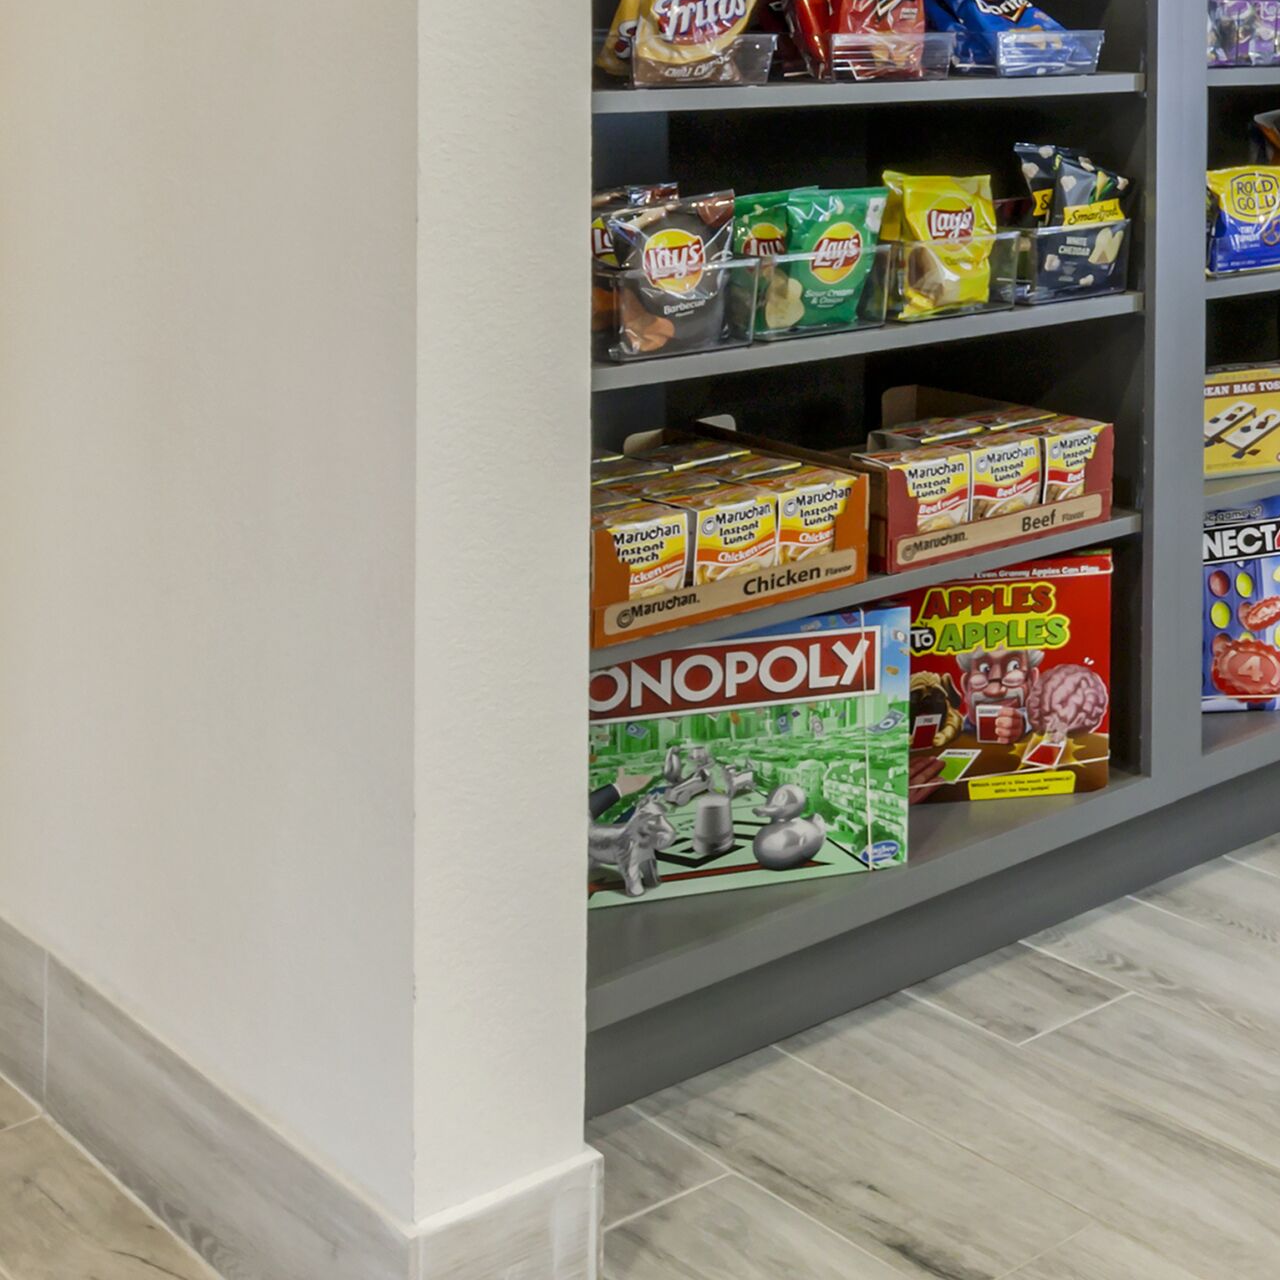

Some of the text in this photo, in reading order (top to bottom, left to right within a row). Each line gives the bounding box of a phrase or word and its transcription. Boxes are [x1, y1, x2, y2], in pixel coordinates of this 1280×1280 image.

[1236, 179, 1273, 194] ROLD
[1237, 193, 1277, 211] GOLD
[930, 207, 974, 242] Lay's
[646, 240, 705, 279] Lay's
[812, 236, 861, 270] Lay's
[1058, 245, 1092, 257] CHEDDAR
[1233, 383, 1256, 394] BAG
[1059, 433, 1098, 451] Marucha
[987, 444, 1036, 464] Maruchan
[1062, 447, 1093, 460] Instant
[908, 461, 965, 480] Maruchan
[990, 460, 1024, 475] Instant
[994, 469, 1021, 483] Lunch
[912, 477, 951, 491] Instant
[916, 486, 947, 498] Lunch
[996, 484, 1017, 498] Beef
[796, 487, 852, 508] Maruchan
[715, 501, 772, 525] Maruchan
[800, 502, 840, 518] Instant
[919, 501, 942, 515] Beef
[719, 520, 760, 537] Instant
[804, 513, 836, 527] Lunch
[1022, 509, 1057, 532] Beef
[1062, 510, 1085, 523] Flavor
[613, 522, 681, 546] Maruchan
[723, 531, 756, 546] Lunch
[1203, 523, 1277, 560] NECT
[616, 540, 664, 557] Instant
[718, 547, 757, 563] Chicken
[630, 565, 663, 586] icken
[743, 565, 821, 597] Chicken
[825, 563, 853, 577] Flavor
[922, 584, 1055, 620] APPLES
[936, 618, 1069, 653] APPLES
[589, 638, 870, 712] ONOPOLY
